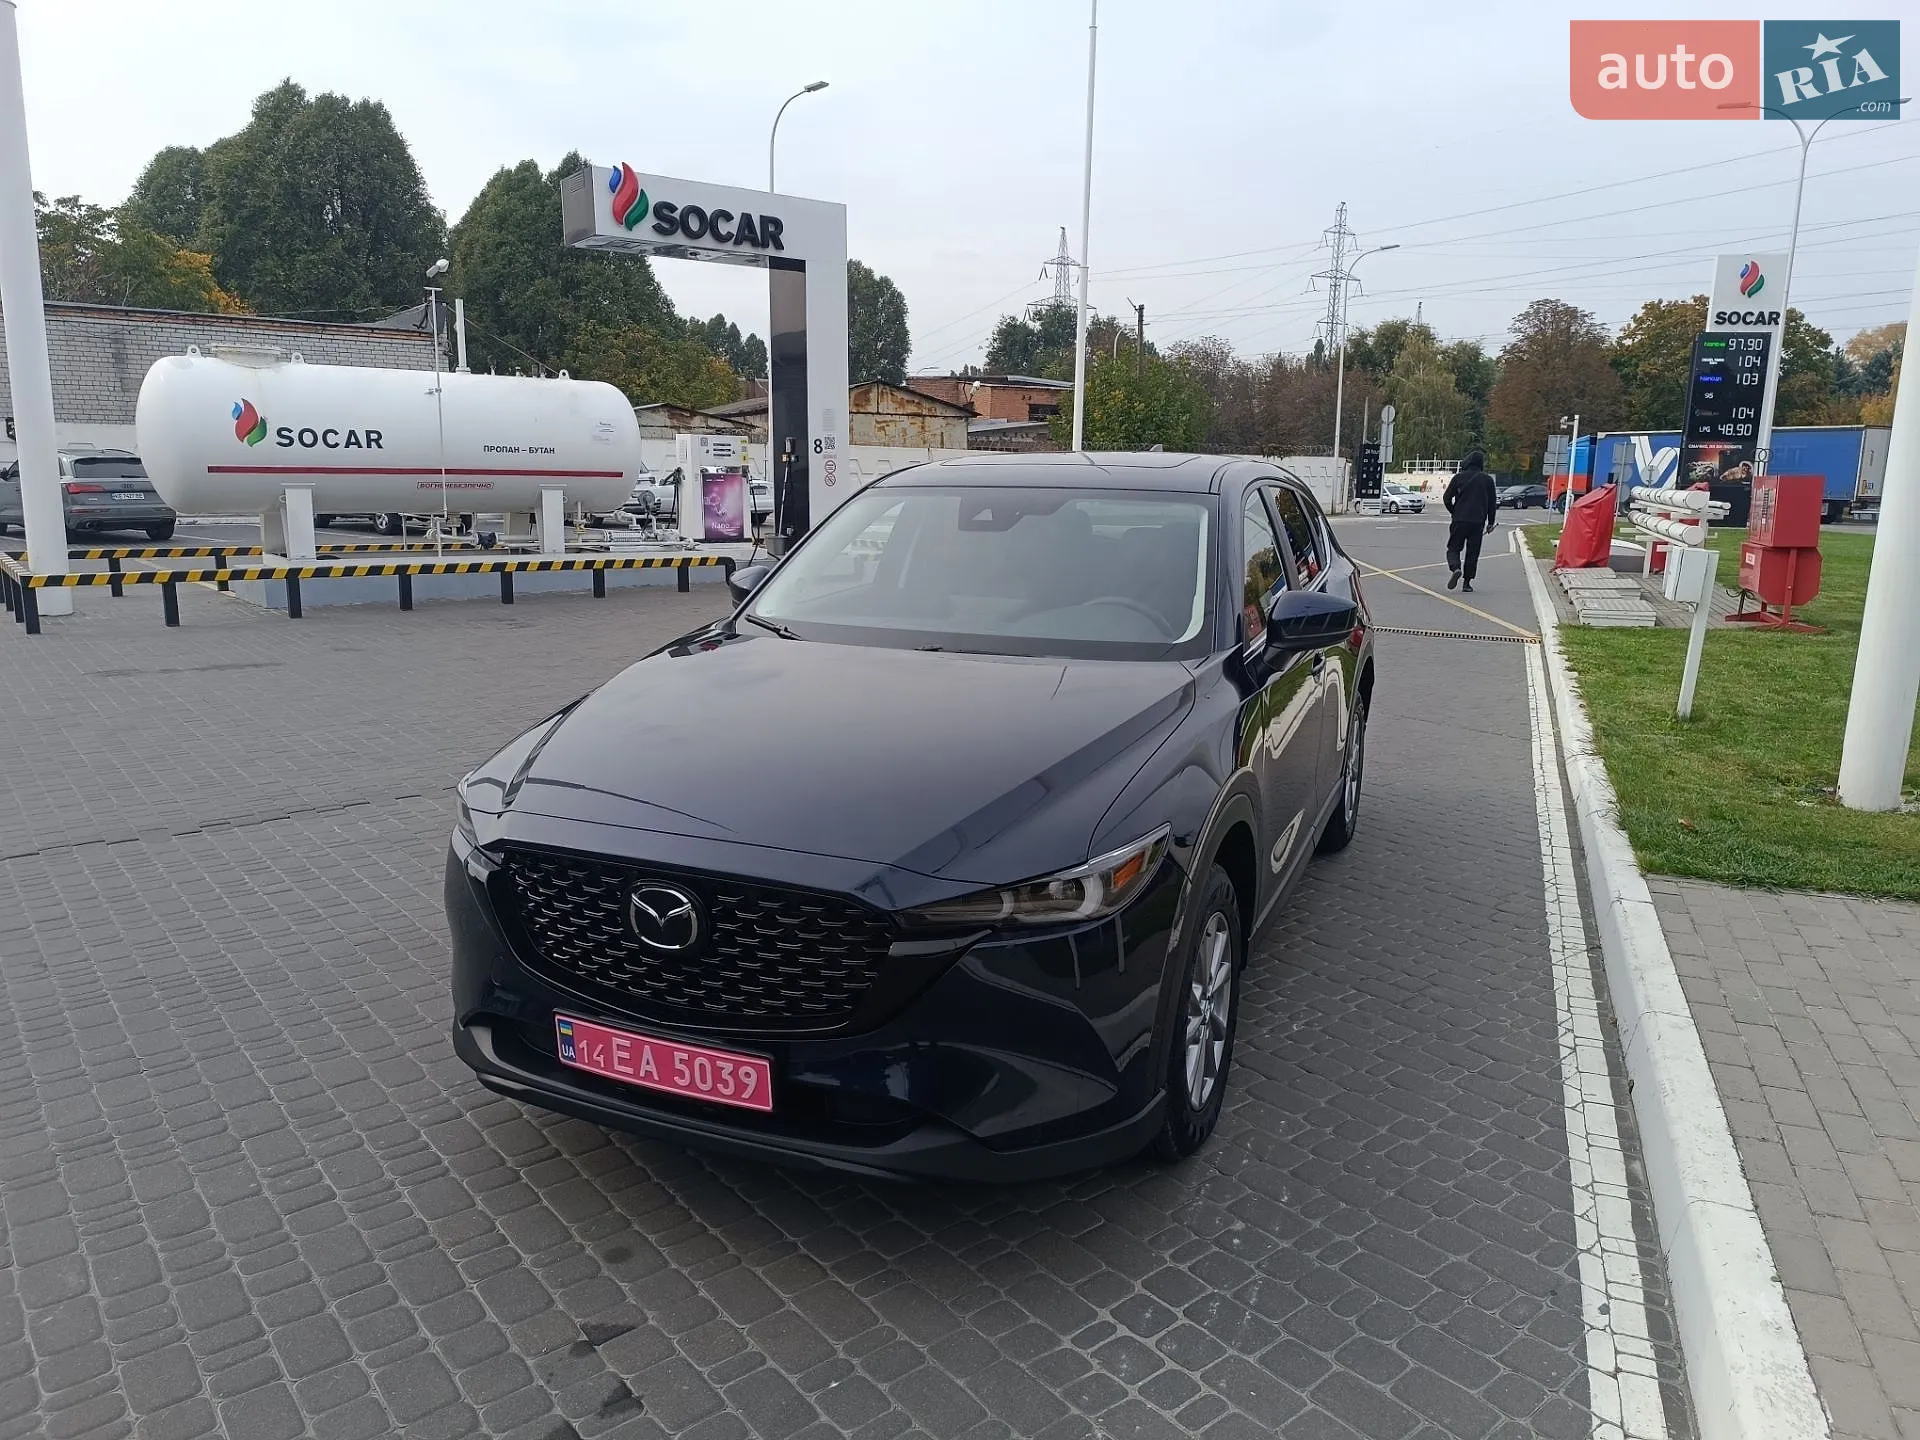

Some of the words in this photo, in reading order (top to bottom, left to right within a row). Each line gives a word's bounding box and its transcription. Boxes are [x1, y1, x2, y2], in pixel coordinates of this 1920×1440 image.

[651, 200, 785, 251] SOCAR
[1714, 310, 1781, 326] SOCAR
[1728, 338, 1763, 351] 97.90
[1738, 355, 1761, 368] 104
[1736, 373, 1759, 385] 103
[1732, 407, 1755, 419] 104
[1718, 423, 1752, 436] 48.90
[275, 426, 384, 449] SOCAR
[483, 445, 520, 454] ПРОПАН
[528, 446, 555, 455] БУТАН
[813, 438, 823, 454] 8
[561, 1043, 576, 1059] UA
[673, 1052, 758, 1099] 5039
